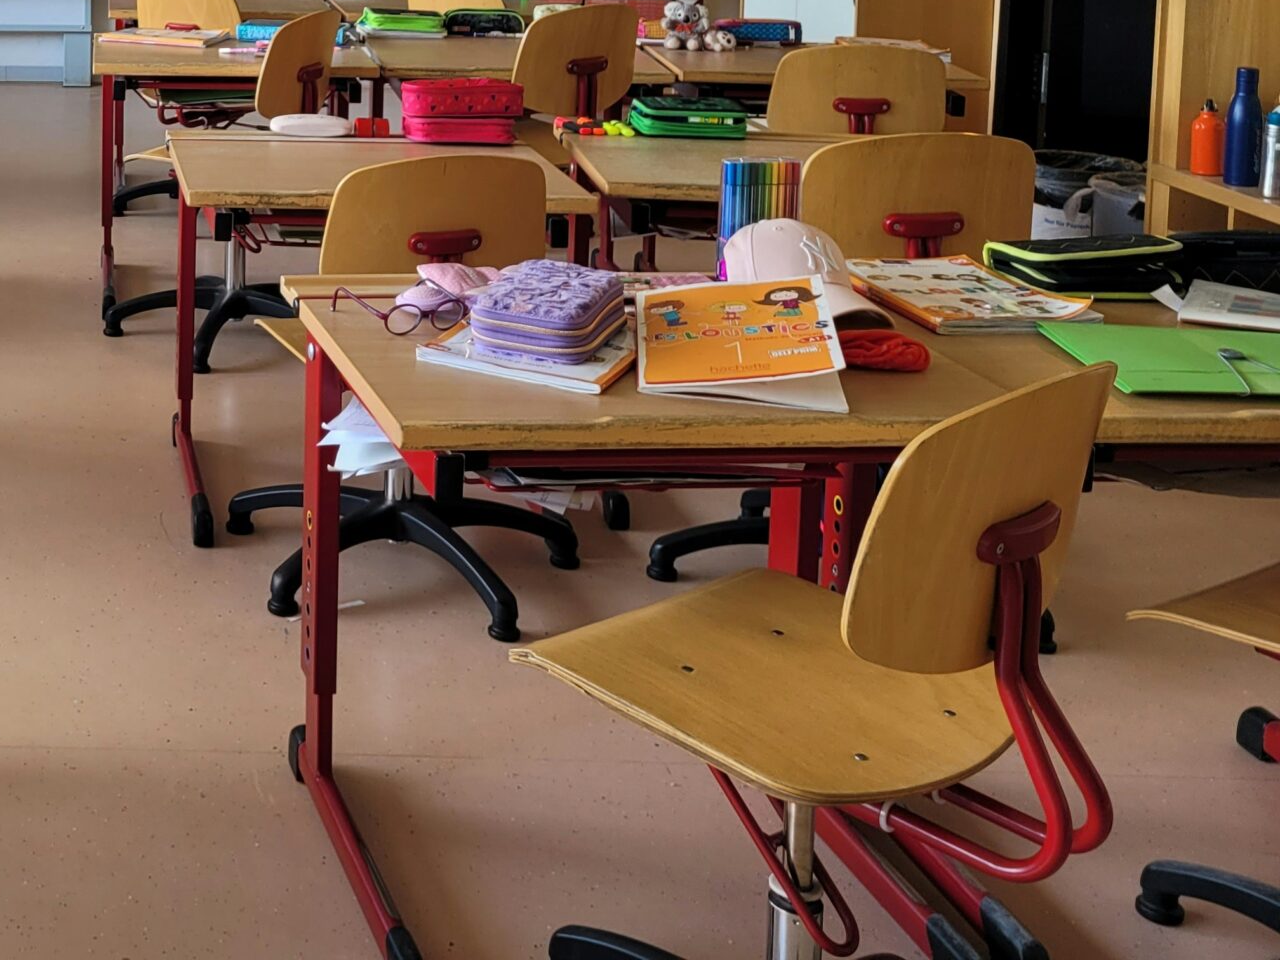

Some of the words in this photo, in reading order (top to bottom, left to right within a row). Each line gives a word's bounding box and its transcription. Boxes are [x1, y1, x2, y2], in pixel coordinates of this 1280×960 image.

[683, 320, 829, 340] LOUSTICS
[724, 341, 742, 364] 1
[709, 363, 771, 374] hachette
